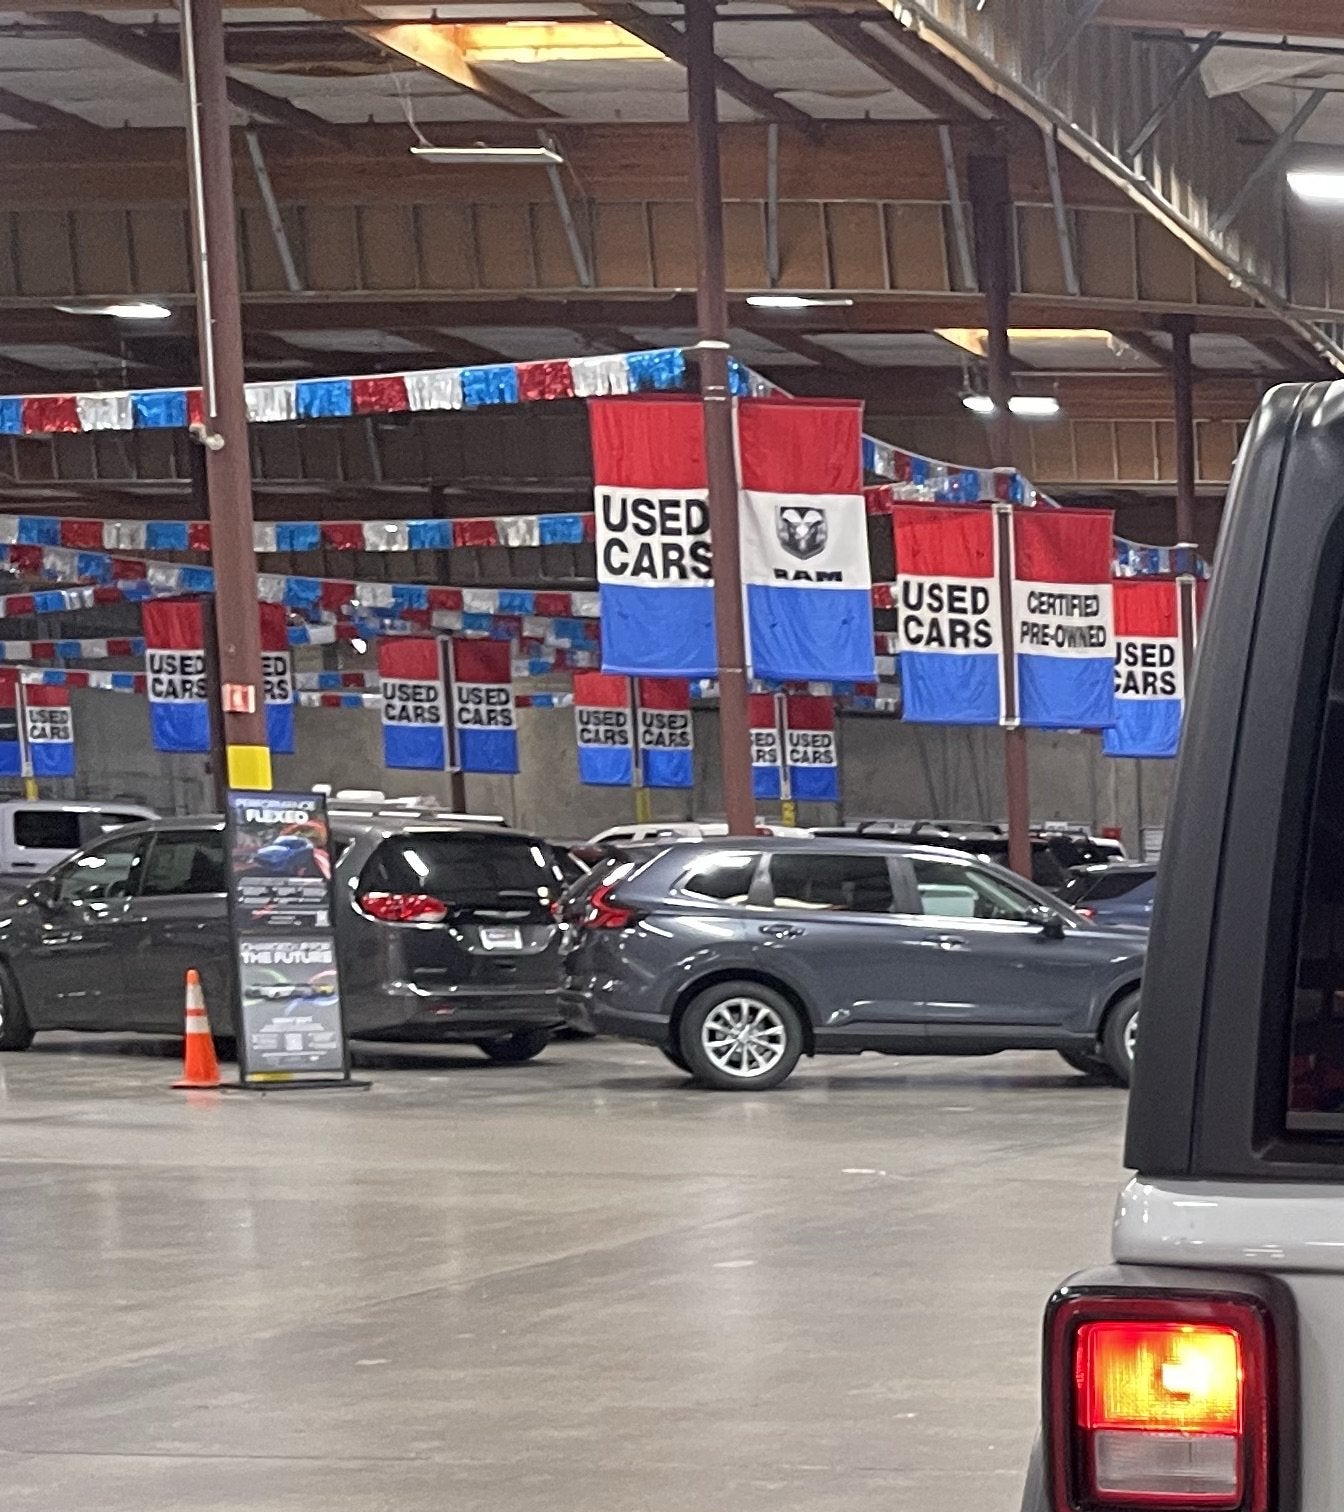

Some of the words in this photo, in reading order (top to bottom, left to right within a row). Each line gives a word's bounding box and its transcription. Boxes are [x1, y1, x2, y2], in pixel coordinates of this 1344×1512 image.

[602, 494, 710, 537] USED
[603, 537, 714, 580] CARS
[902, 580, 990, 616] USED
[1027, 590, 1100, 618] CERTIFIED
[903, 615, 993, 648] CARS
[1020, 621, 1107, 648] PRE-OWNED
[150, 654, 206, 675] USED
[261, 656, 287, 676] ED
[151, 677, 207, 698] CARS
[263, 679, 289, 700] RS
[383, 682, 438, 702] USED
[457, 686, 510, 706] USED
[29, 709, 69, 724] USED
[385, 703, 440, 723] CARS
[458, 707, 513, 726] CARS
[579, 709, 627, 727] USED
[642, 711, 688, 730] USED
[30, 725, 70, 740] CARS
[580, 728, 629, 745] CARS
[754, 732, 776, 747] ED
[789, 732, 832, 748] USED
[755, 748, 777, 763] RS
[790, 748, 833, 764] CARS
